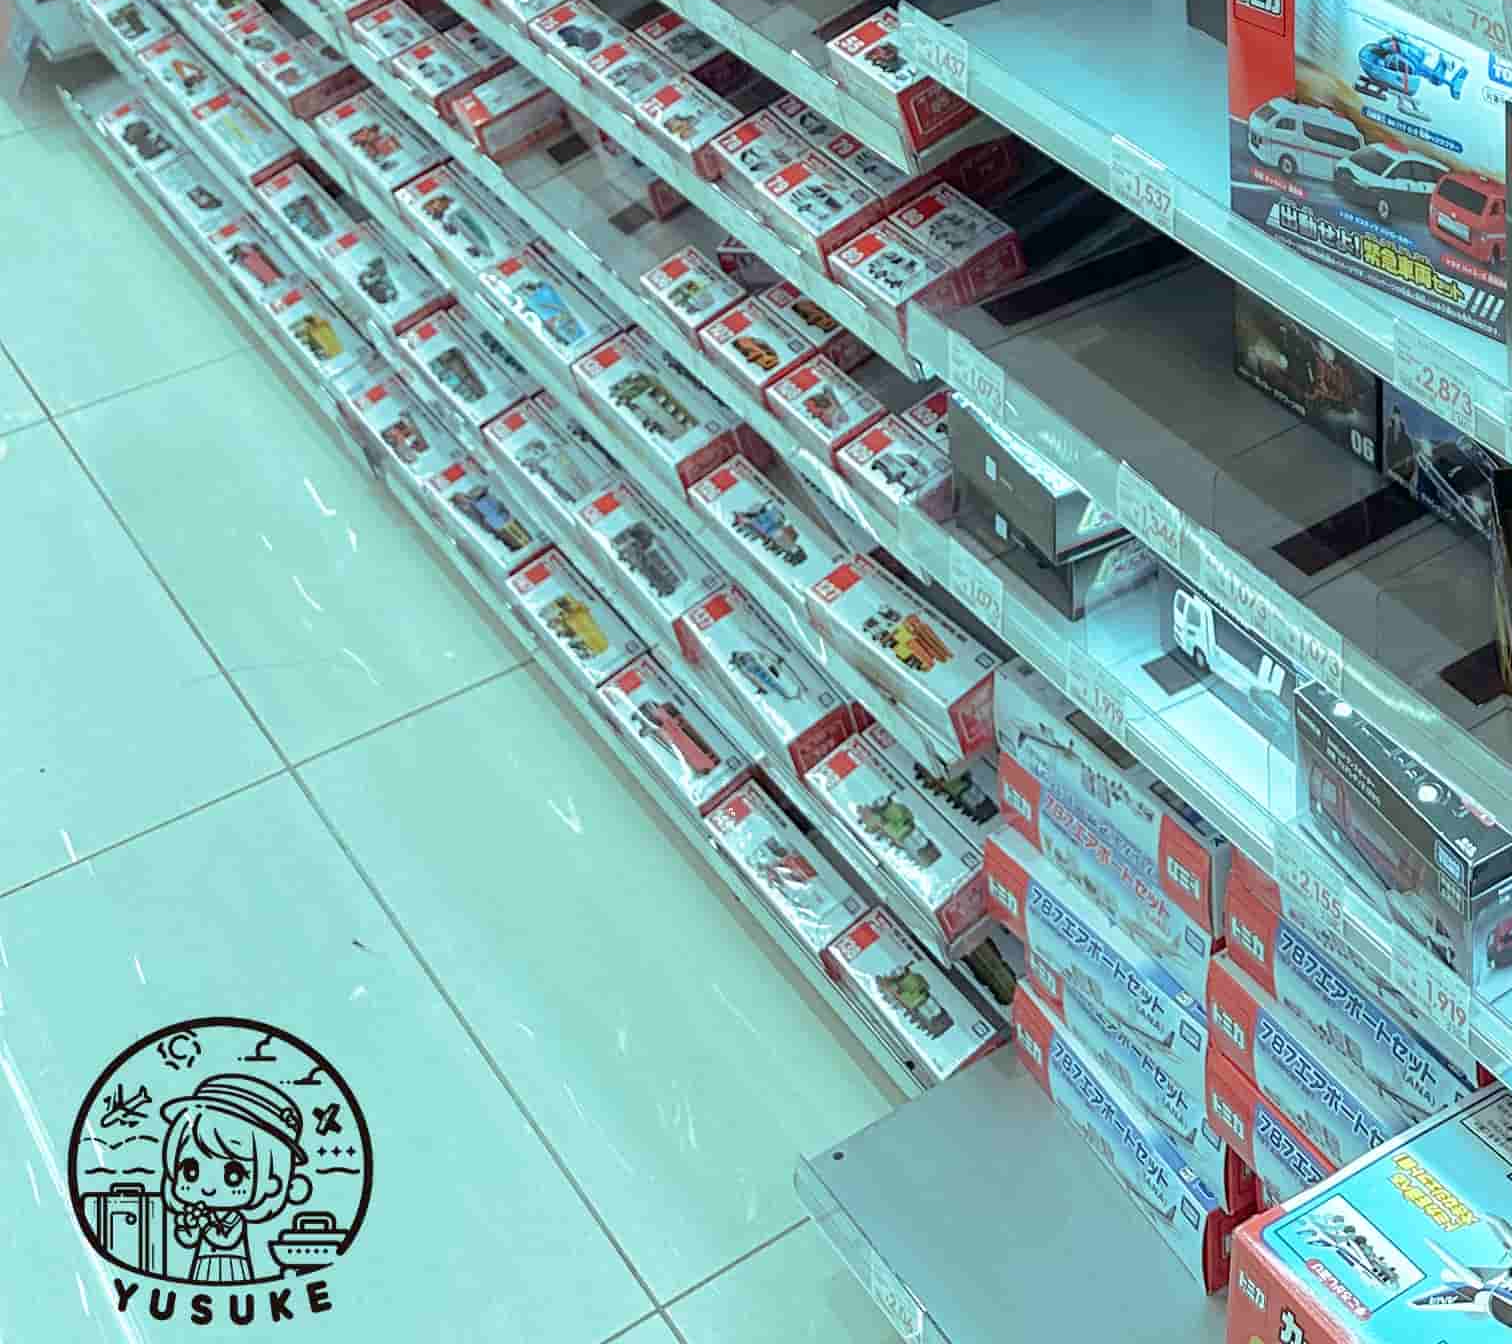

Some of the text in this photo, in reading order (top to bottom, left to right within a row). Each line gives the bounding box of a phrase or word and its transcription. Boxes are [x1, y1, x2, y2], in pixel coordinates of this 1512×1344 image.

[1350, 429, 1376, 462] 06
[1030, 886, 1167, 1018] 787エアポートセット
[1279, 929, 1437, 1087] 787エアポートセット
[1050, 1038, 1170, 1188] 787エアポートセット
